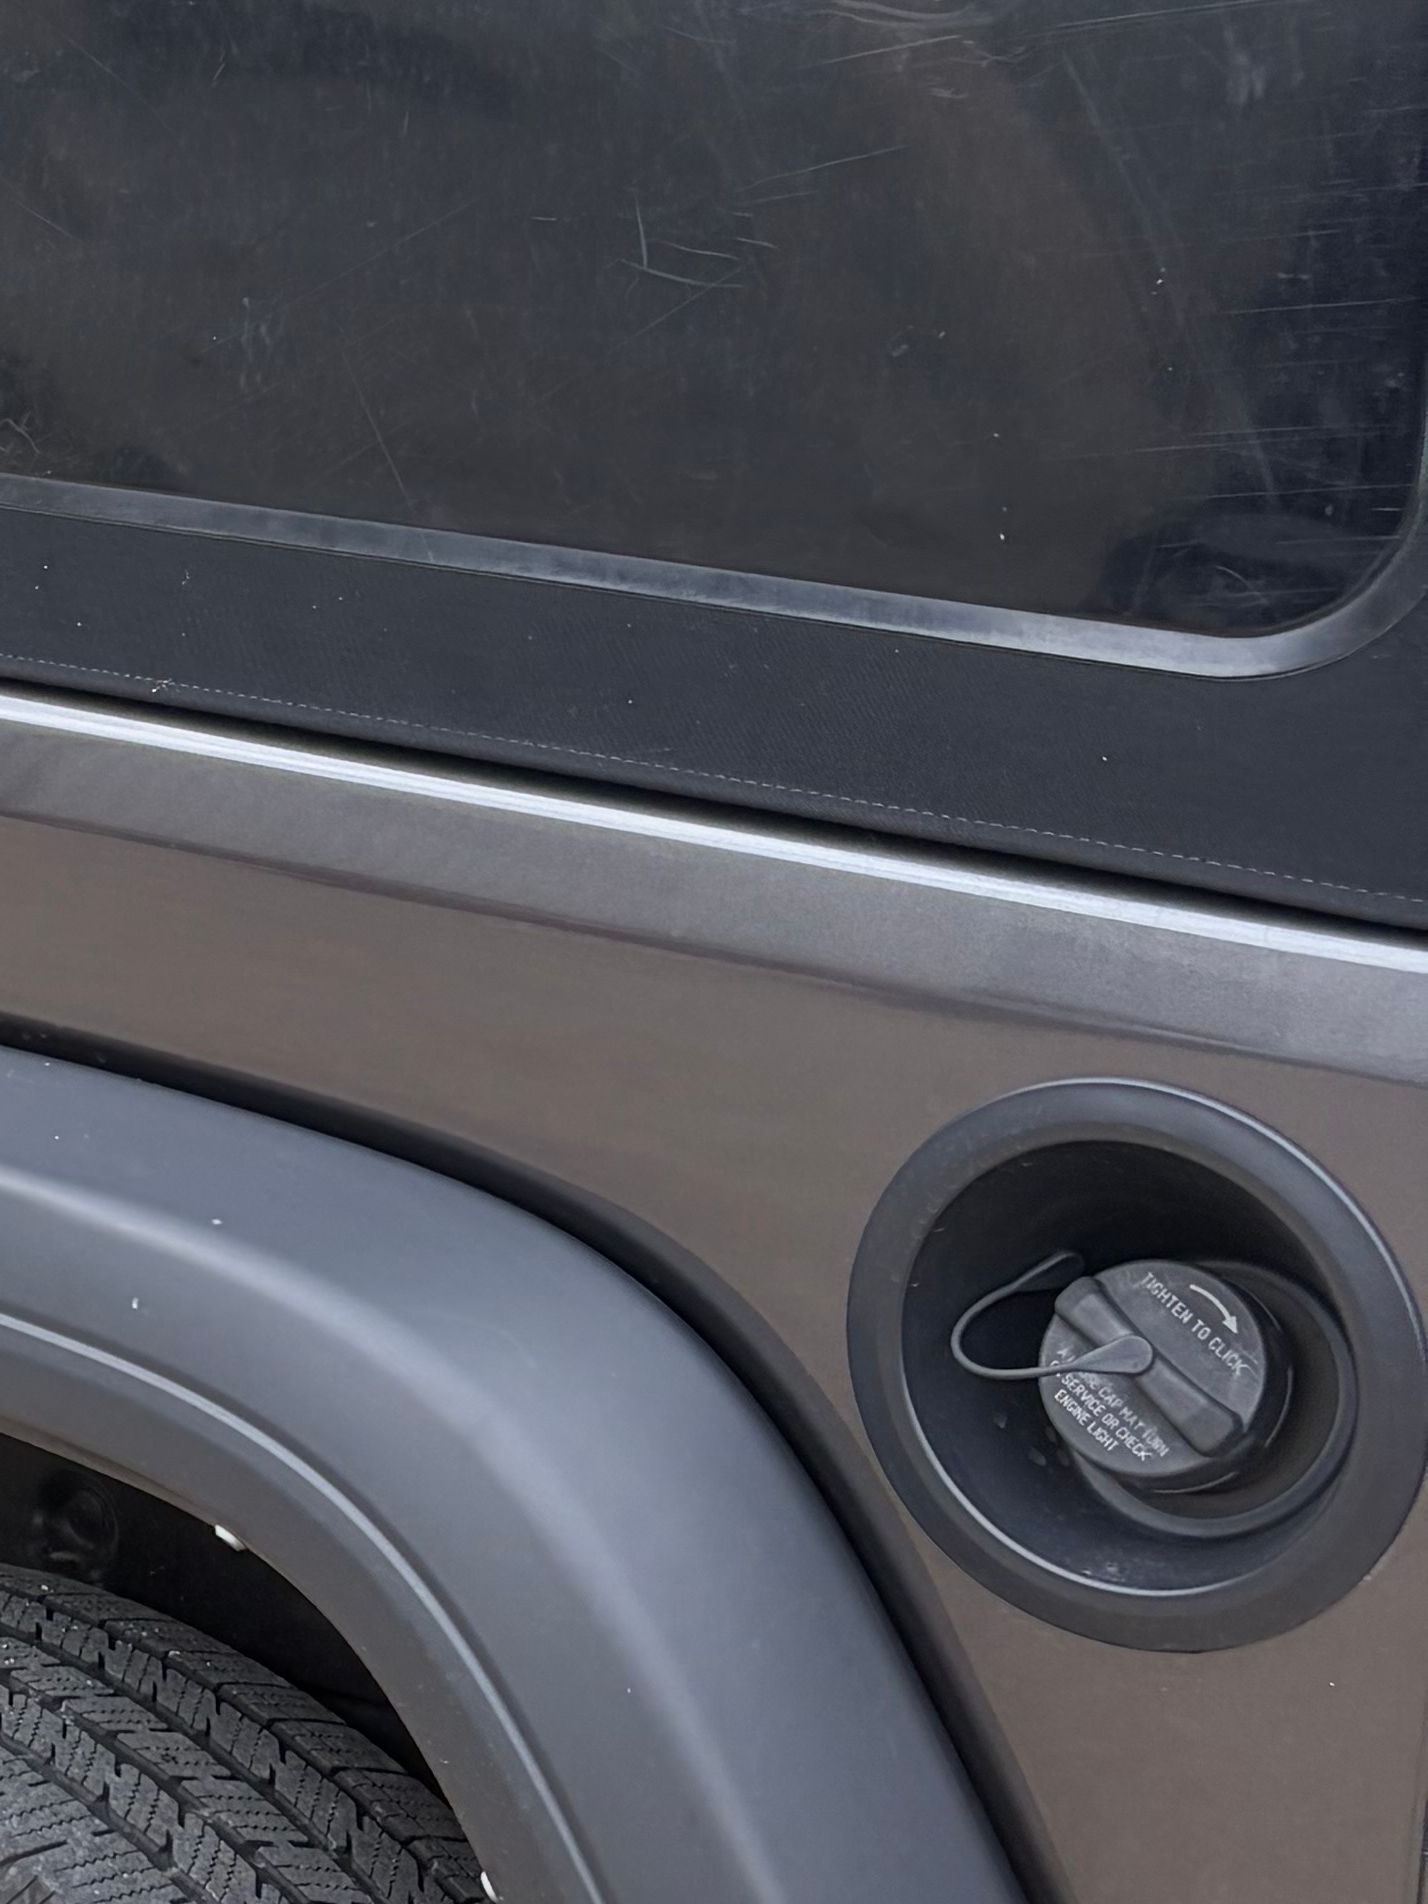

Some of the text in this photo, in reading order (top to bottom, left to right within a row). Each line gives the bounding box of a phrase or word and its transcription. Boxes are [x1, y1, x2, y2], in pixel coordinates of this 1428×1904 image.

[1140, 1272, 1245, 1376] TIGHTEN TO CLICK
[1054, 1389, 1120, 1451] ENGINE LIGHT
[1061, 1373, 1152, 1462] SERVICE OR CHECK
[1119, 1406, 1145, 1430] MAY
